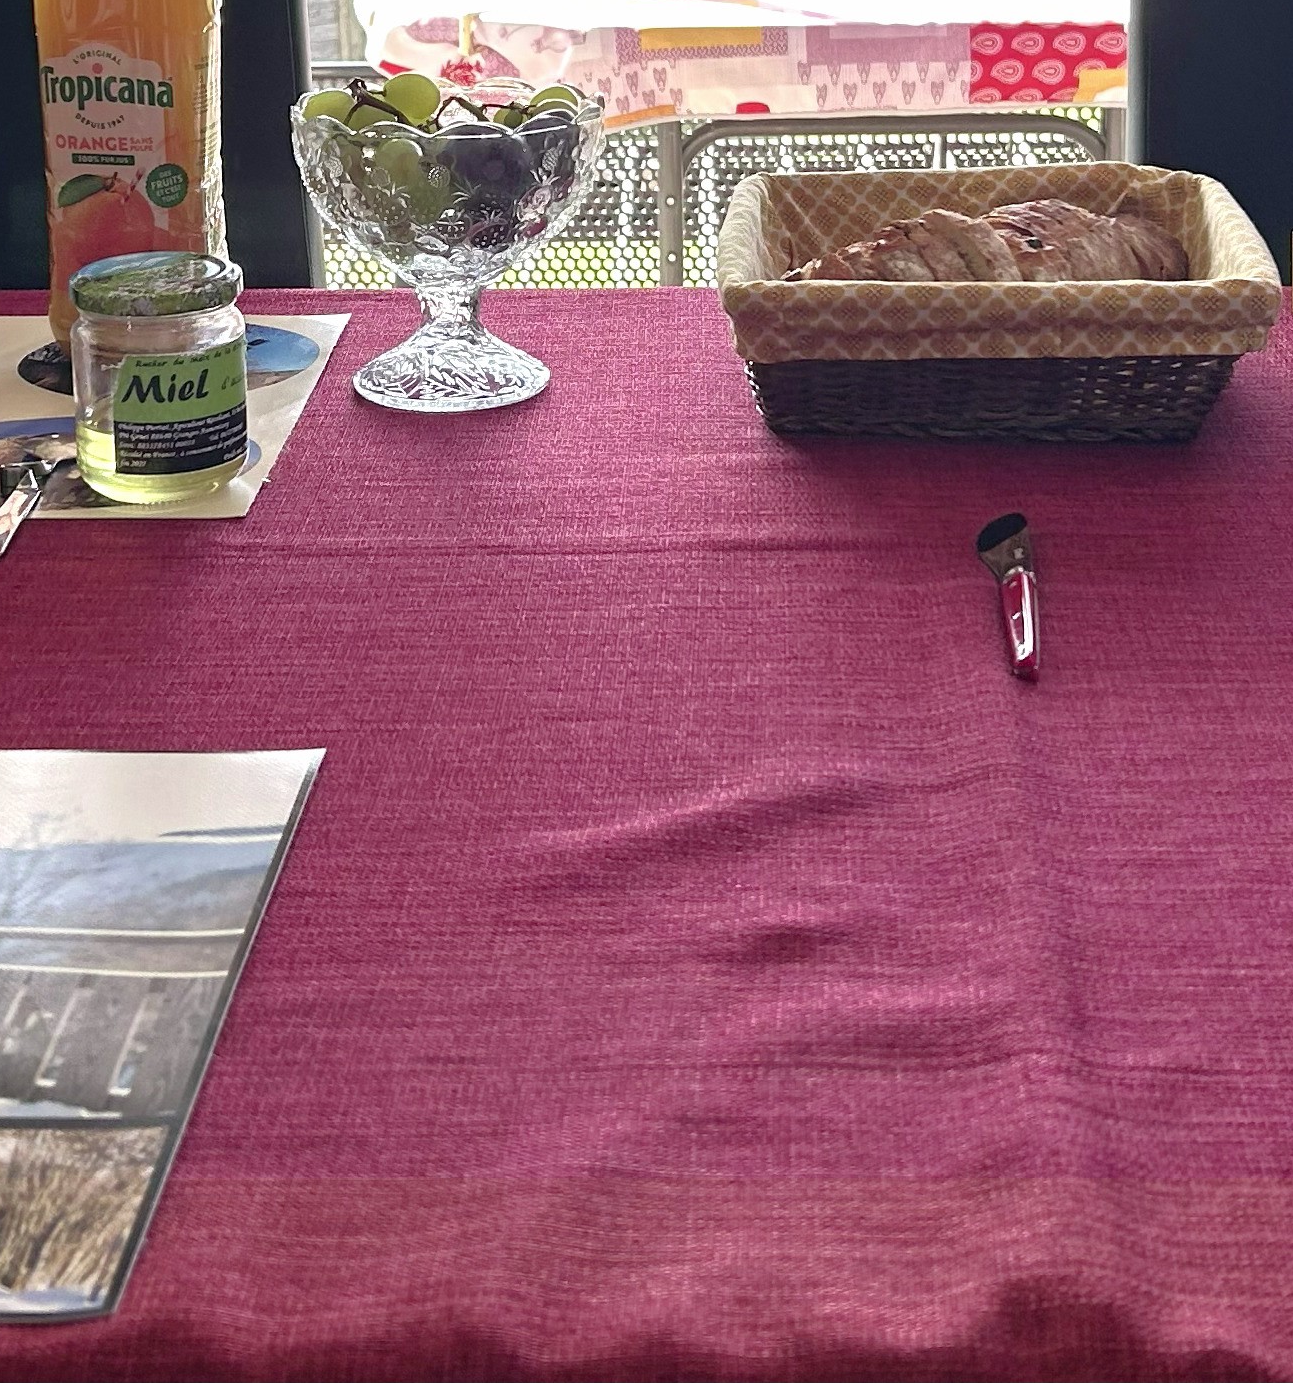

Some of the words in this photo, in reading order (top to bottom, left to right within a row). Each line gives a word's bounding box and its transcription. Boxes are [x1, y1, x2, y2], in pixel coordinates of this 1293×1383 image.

[72, 49, 121, 65] L'ORIGINAL
[41, 65, 174, 110] Tropicana
[75, 112, 106, 130] DEPUIS
[55, 134, 128, 151] ORANGE
[151, 174, 183, 191] FRUITS
[121, 368, 209, 404] Miel
